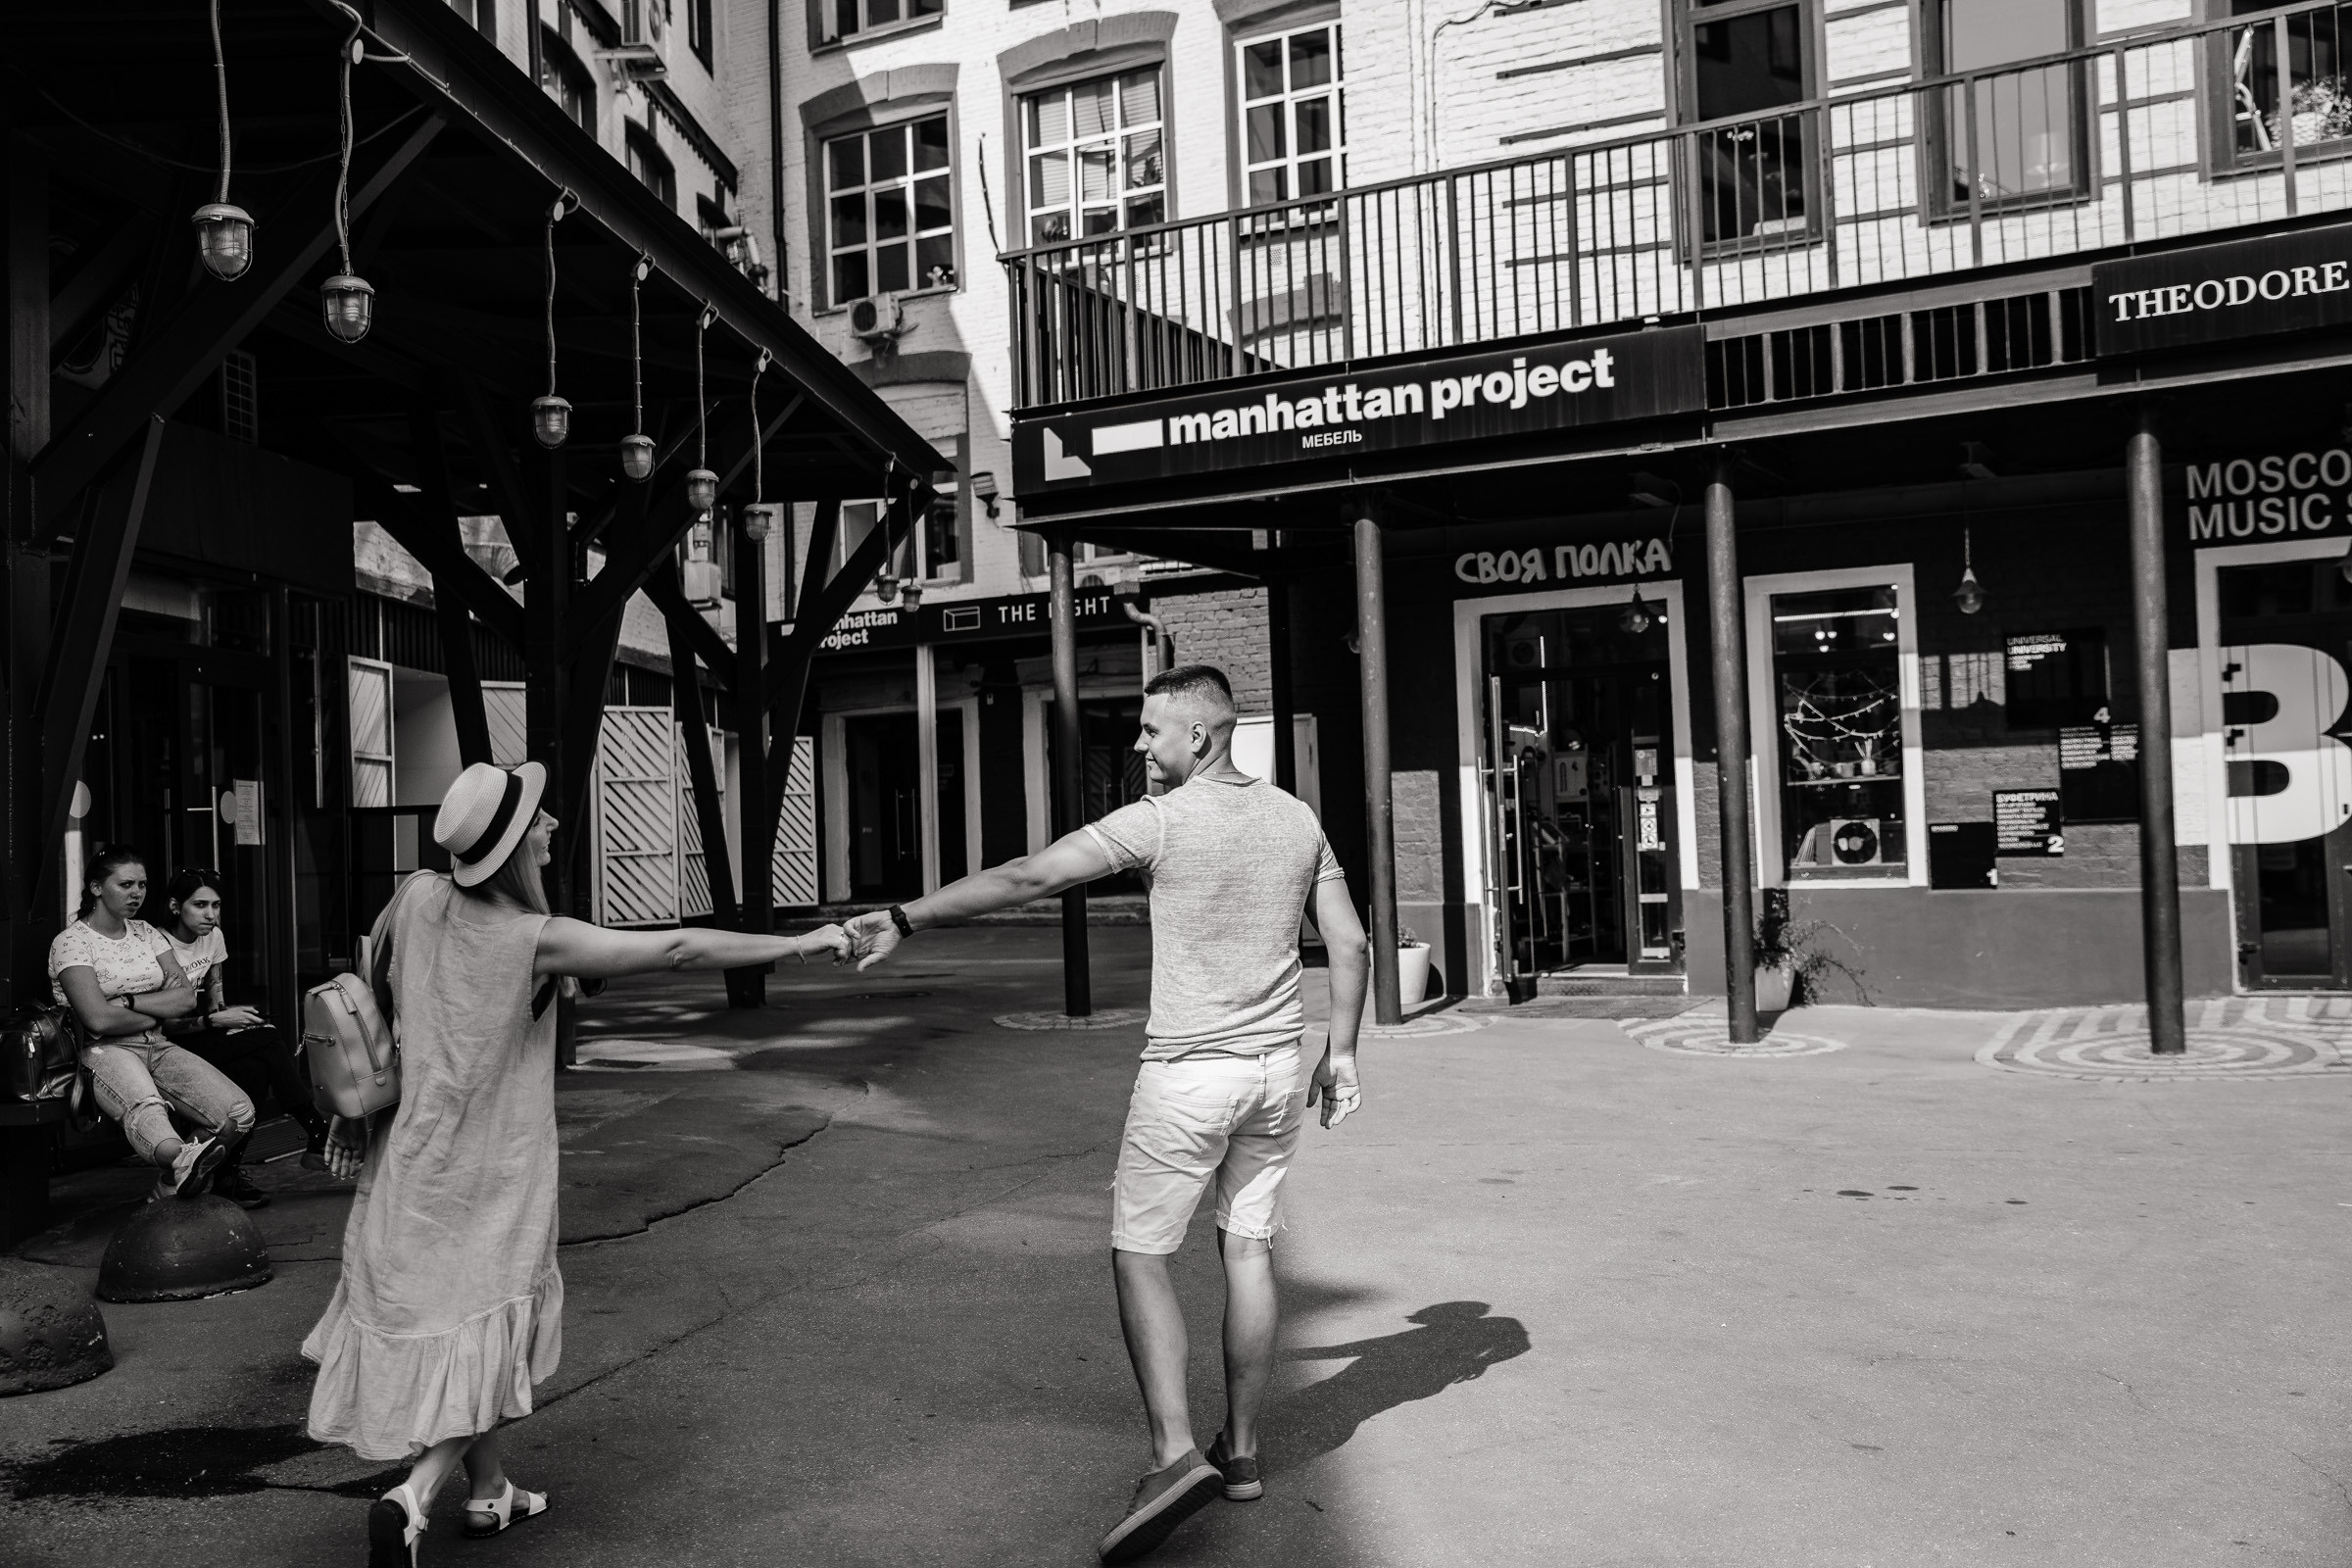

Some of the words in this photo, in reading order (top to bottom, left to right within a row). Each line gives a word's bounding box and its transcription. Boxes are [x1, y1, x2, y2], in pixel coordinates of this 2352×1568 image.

[2108, 260, 2351, 322] THEODORE
[1169, 382, 1424, 446] manhattan
[1430, 347, 1615, 420] project
[1301, 429, 1363, 449] МЕБЕЛЬ
[2185, 449, 2352, 500] MOSCO
[2187, 493, 2332, 541] MUSIC
[1454, 547, 1547, 584] СВОЯ
[1554, 538, 1672, 579] ПОЛКА
[832, 611, 898, 631] nhattan
[998, 603, 1037, 623] THE
[818, 628, 869, 651] roject
[2093, 707, 2111, 724] 4
[2047, 835, 2065, 854] 2
[1985, 867, 1998, 886] 1
